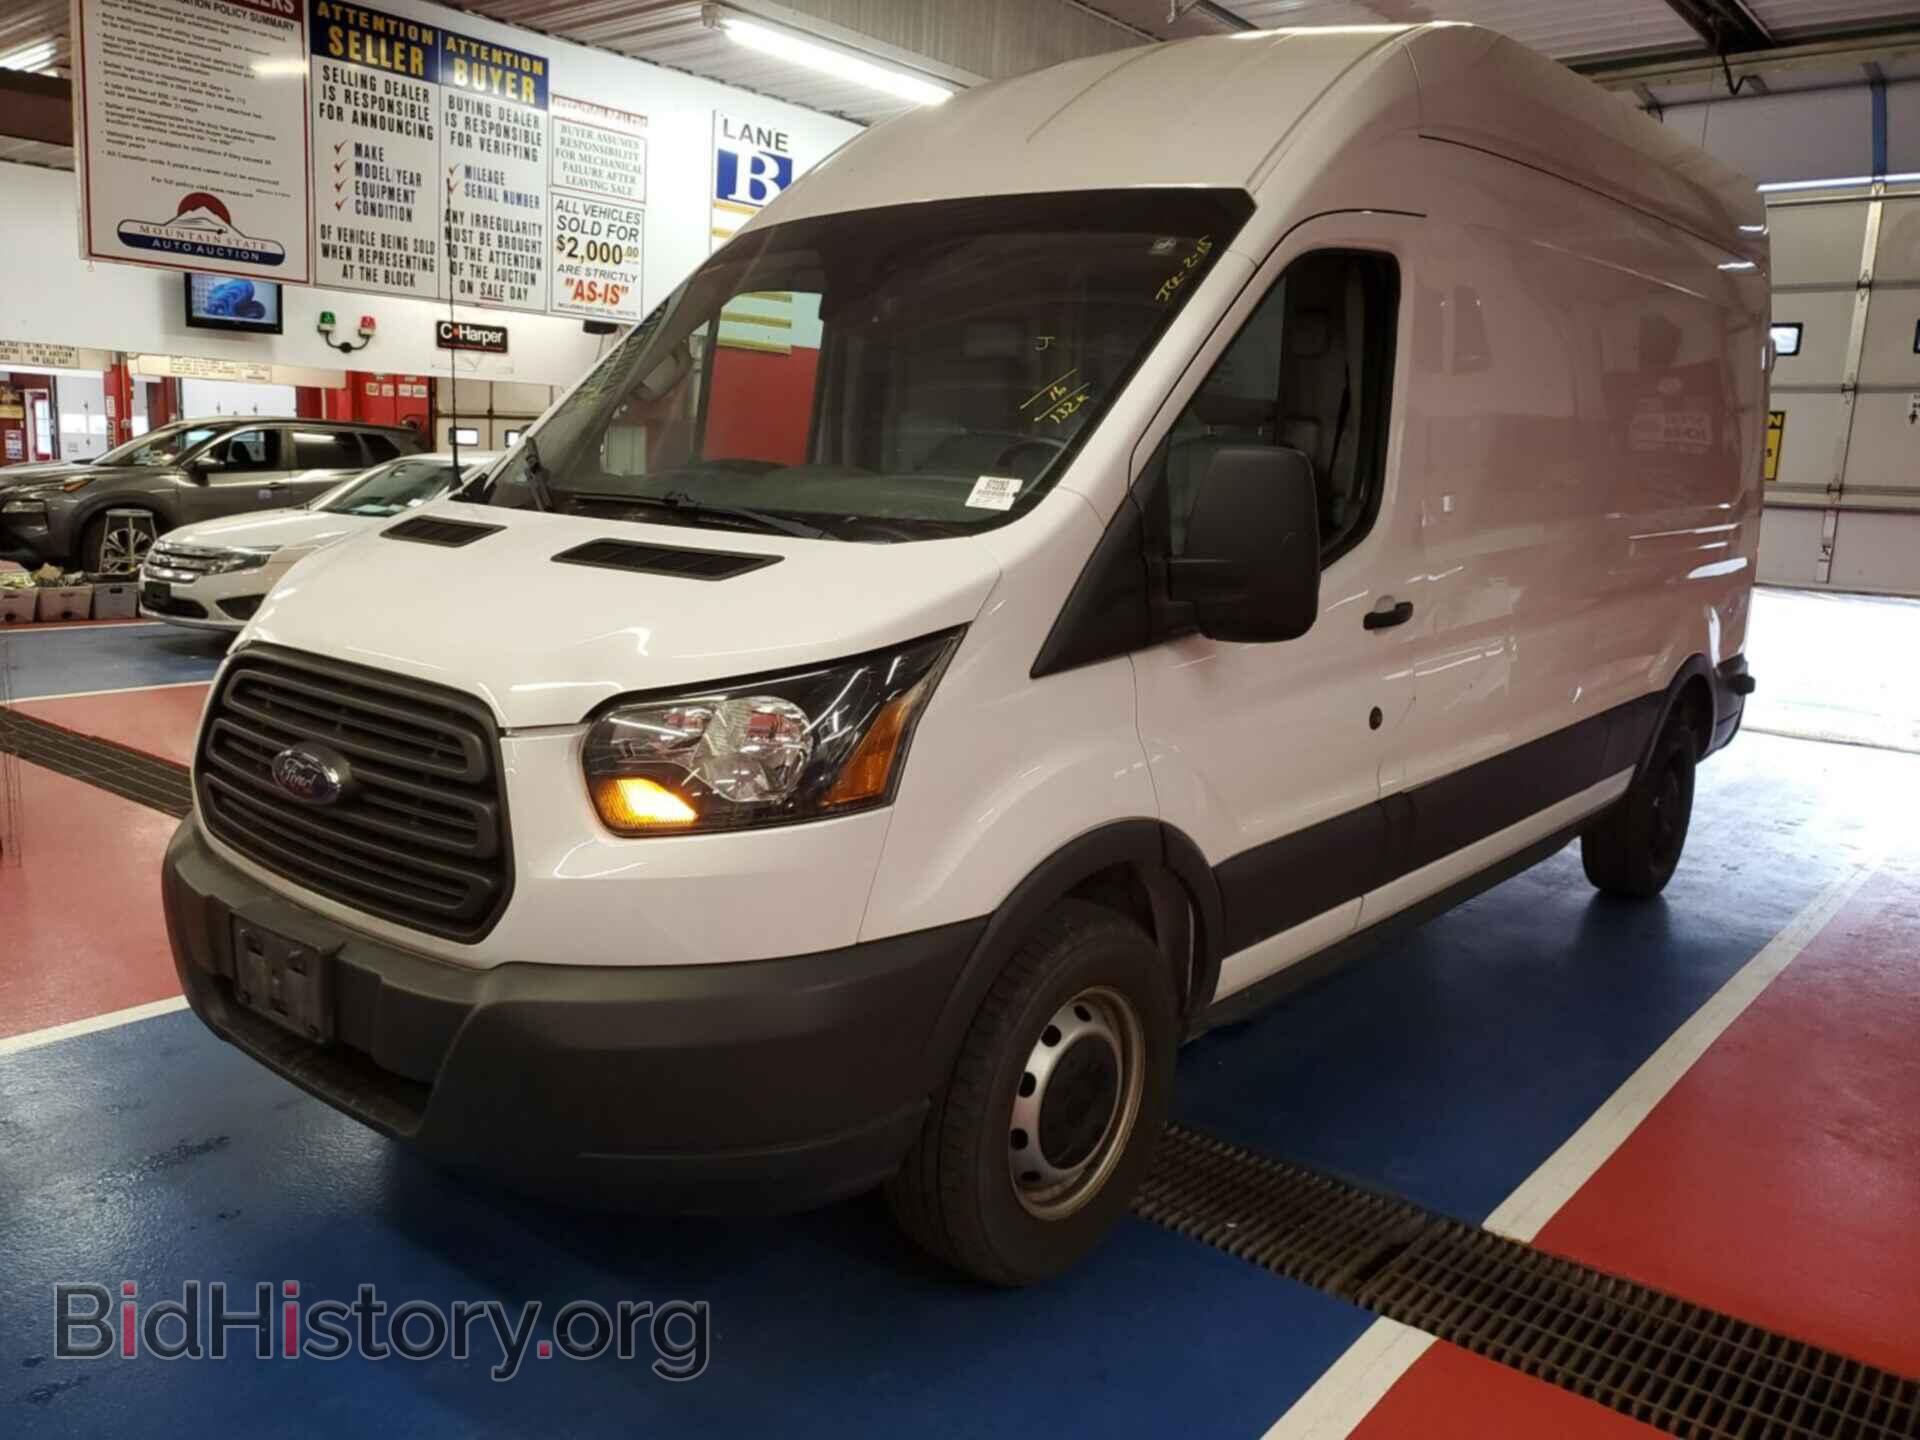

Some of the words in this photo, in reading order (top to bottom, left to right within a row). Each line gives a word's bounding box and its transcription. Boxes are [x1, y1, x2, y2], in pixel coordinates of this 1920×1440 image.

[213, 2, 248, 19] POLICY
[250, 9, 295, 31] SUMMARY
[317, 2, 434, 46] ATTENTION
[328, 25, 424, 77] SELLER
[446, 37, 544, 76] ATTENTION
[322, 65, 377, 91] SELLING
[384, 79, 430, 103] DEALER
[453, 58, 536, 104] BUYER
[322, 84, 338, 100] IS
[344, 89, 430, 122] RESPONSIBLE
[448, 94, 492, 118] BUYING
[498, 108, 540, 130] DEALER
[319, 102, 344, 122] FOR
[352, 110, 434, 141] ANNOUNCING
[445, 112, 458, 128] IS
[464, 117, 543, 147] RESPONSIBLE
[723, 118, 789, 153] LANE
[354, 142, 384, 163] MAKE
[450, 131, 473, 148] FOR
[479, 138, 539, 163] VERIFYING
[555, 147, 576, 161] FOR
[464, 165, 505, 186] MILEAGE
[727, 149, 781, 205] B
[355, 180, 416, 205] EQUIPMENT
[464, 182, 500, 203] SERIAL
[503, 190, 540, 209] NUMBER
[355, 199, 413, 223] CONDITION
[444, 208, 464, 225] ANY
[470, 213, 543, 239] IRREGULARITY
[555, 199, 579, 215] ALL
[583, 203, 641, 226] VEHICLES
[139, 225, 222, 244] MOUNTAIN
[226, 238, 267, 251] STATE
[320, 224, 332, 240] OF
[337, 226, 376, 248] VEHICLE
[381, 232, 409, 251] BEING
[413, 238, 436, 256] SOLD
[445, 226, 473, 244] MUST
[479, 230, 492, 247] BE
[497, 233, 543, 255] BROUGHT
[557, 215, 602, 237] SOLD
[606, 223, 640, 242] FOR
[152, 238, 193, 252] AUTO
[196, 242, 260, 261] AUCTION
[320, 243, 352, 262] WHEN
[358, 247, 435, 273] REPRESENTING
[446, 243, 458, 259] TO
[463, 246, 483, 262] THE
[489, 250, 542, 272] ATTENTION
[342, 264, 354, 280] AT
[359, 267, 379, 284] THE
[384, 270, 416, 289] BLOCK
[451, 260, 464, 276] OF
[469, 262, 489, 280] THE
[494, 266, 537, 286] AUCTION
[557, 263, 582, 276] ARE
[584, 268, 638, 284] STRICTLY
[459, 279, 475, 295] ON
[480, 282, 504, 298] SALE
[510, 285, 528, 301] DAY
[565, 277, 630, 305] "AS-IS"
